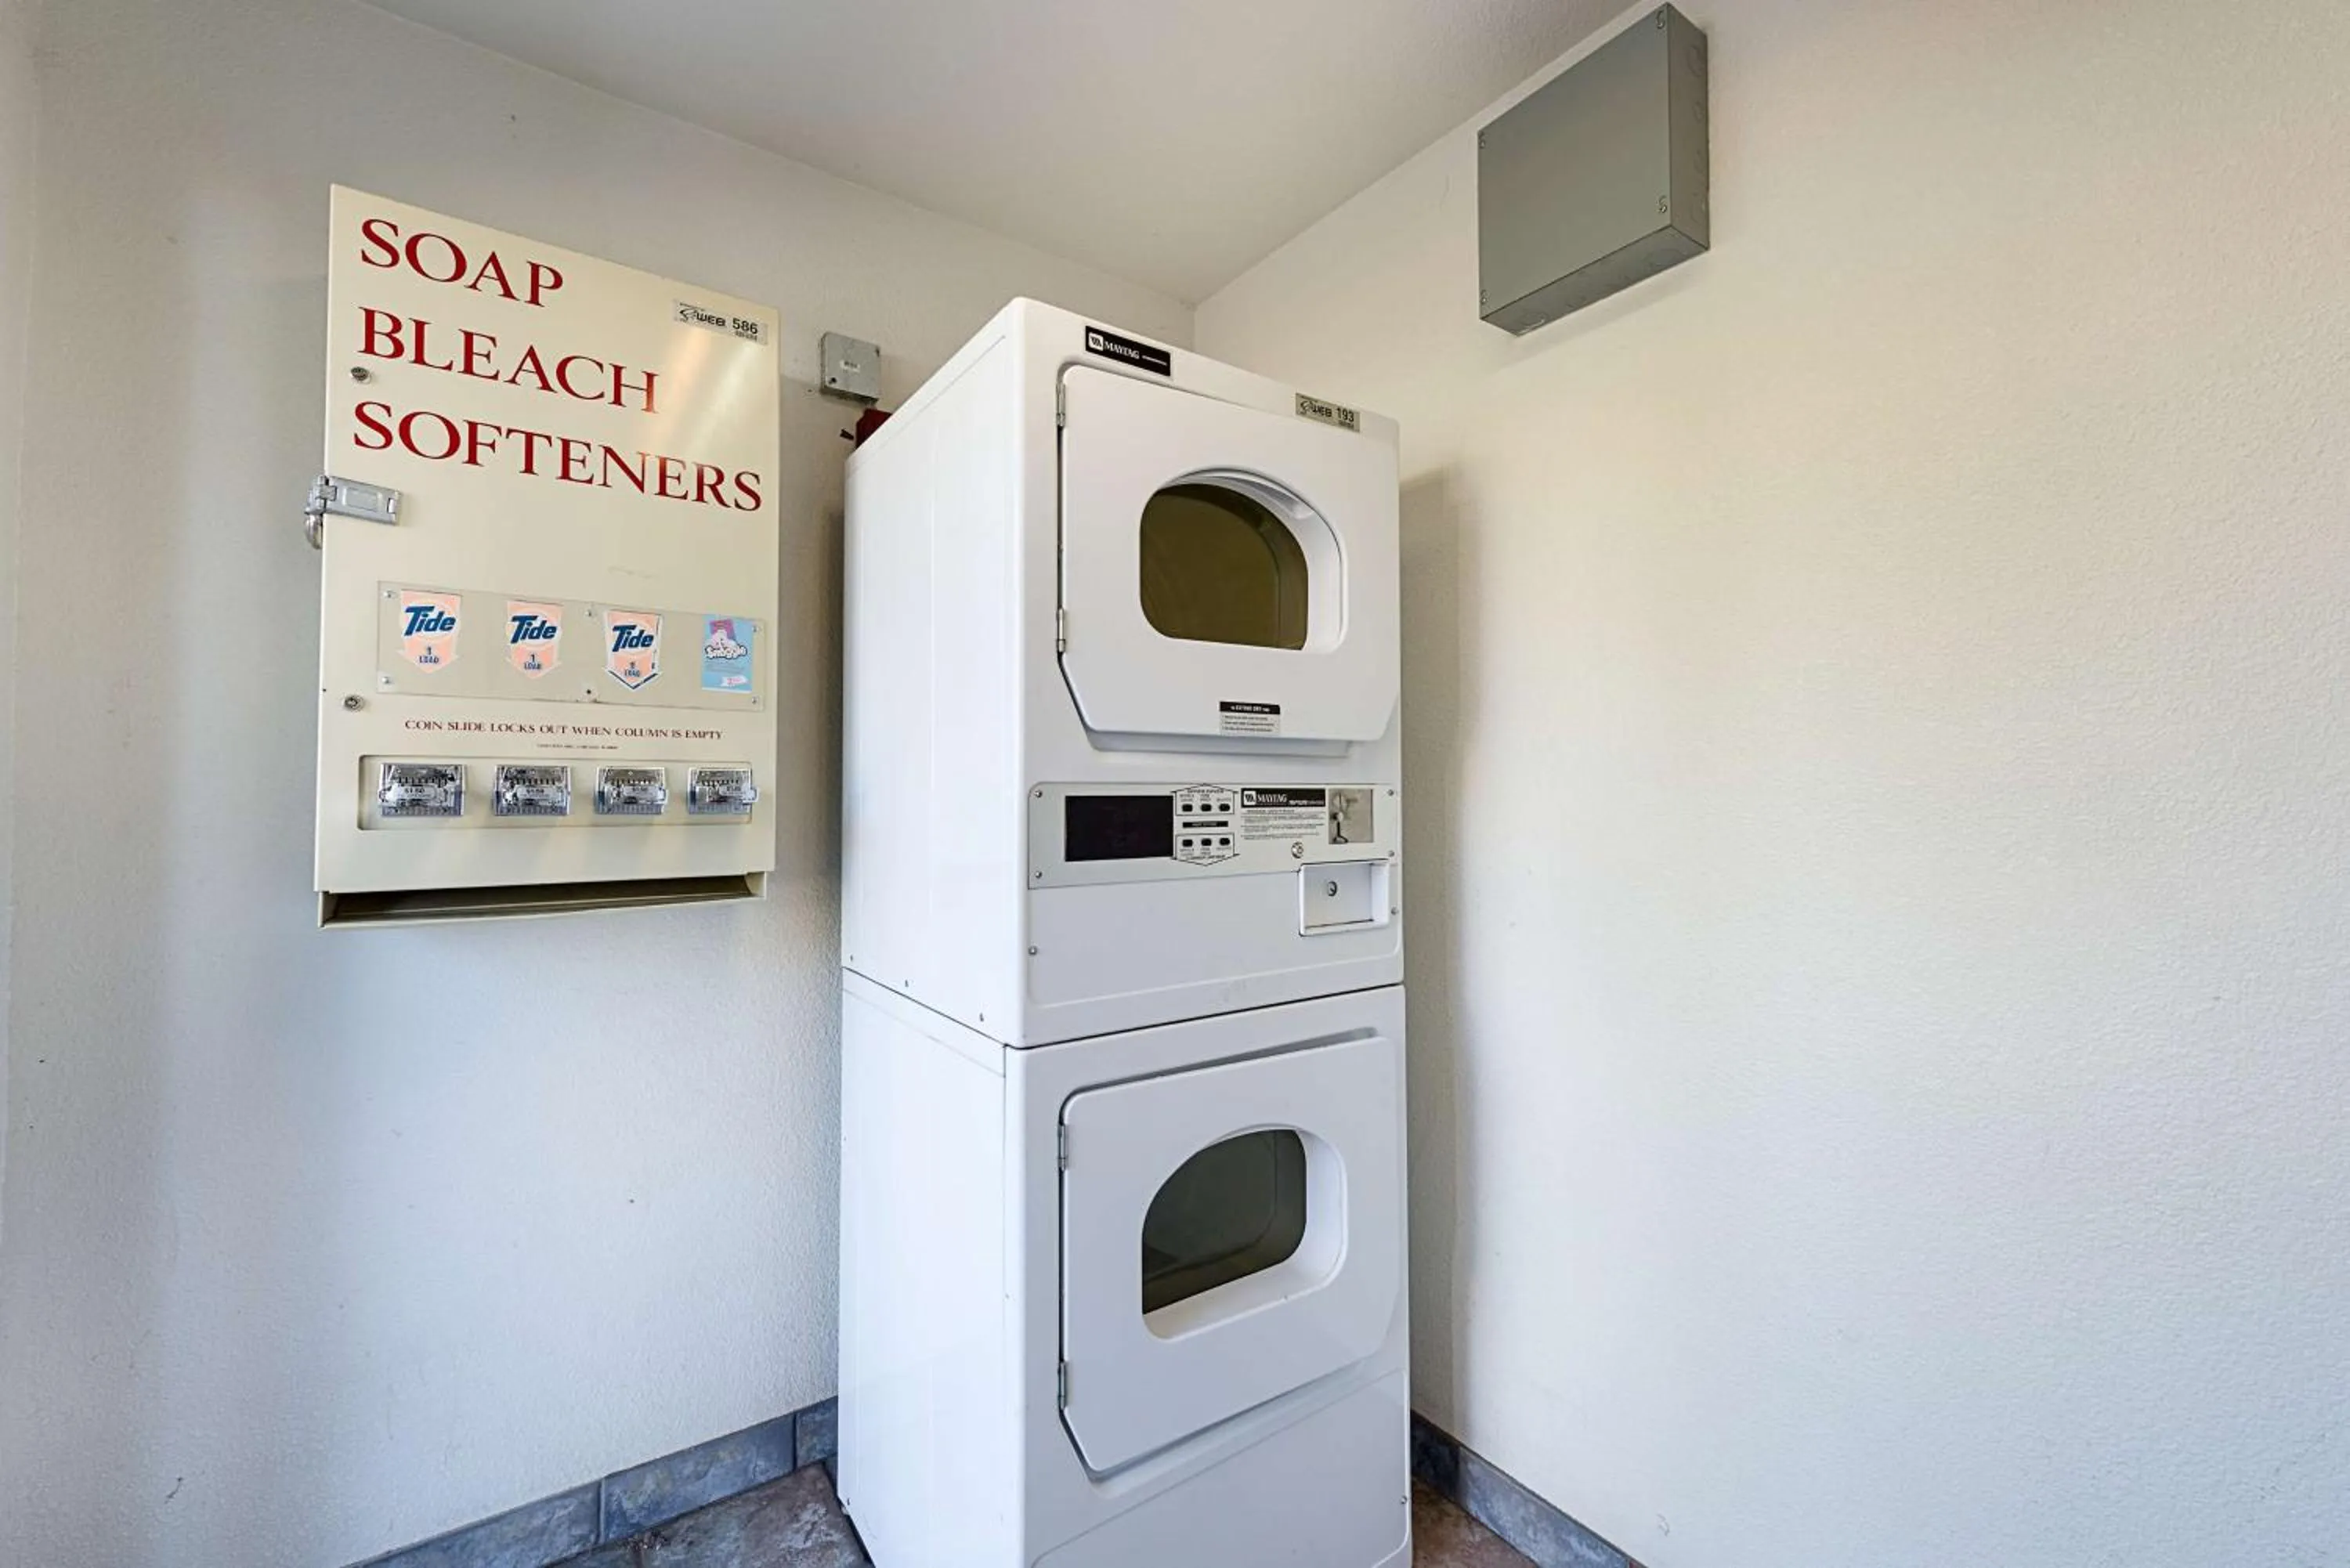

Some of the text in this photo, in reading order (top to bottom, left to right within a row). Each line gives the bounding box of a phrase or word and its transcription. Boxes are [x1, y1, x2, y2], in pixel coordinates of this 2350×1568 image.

[361, 219, 563, 308] SOAP
[696, 313, 758, 334] WEB 586
[357, 305, 660, 414] BLEACH
[1104, 341, 1141, 359] MAYTAG
[1336, 406, 1354, 423] 193
[352, 400, 763, 512] SOFTENERS
[403, 605, 457, 637] Tide
[510, 615, 558, 644] Tide
[612, 624, 654, 652] Tide
[404, 719, 724, 740] COIN SLIDE LOCKS OUT WHEN COLUMN IS EMPTY
[1257, 793, 1288, 804] MAYTAG
